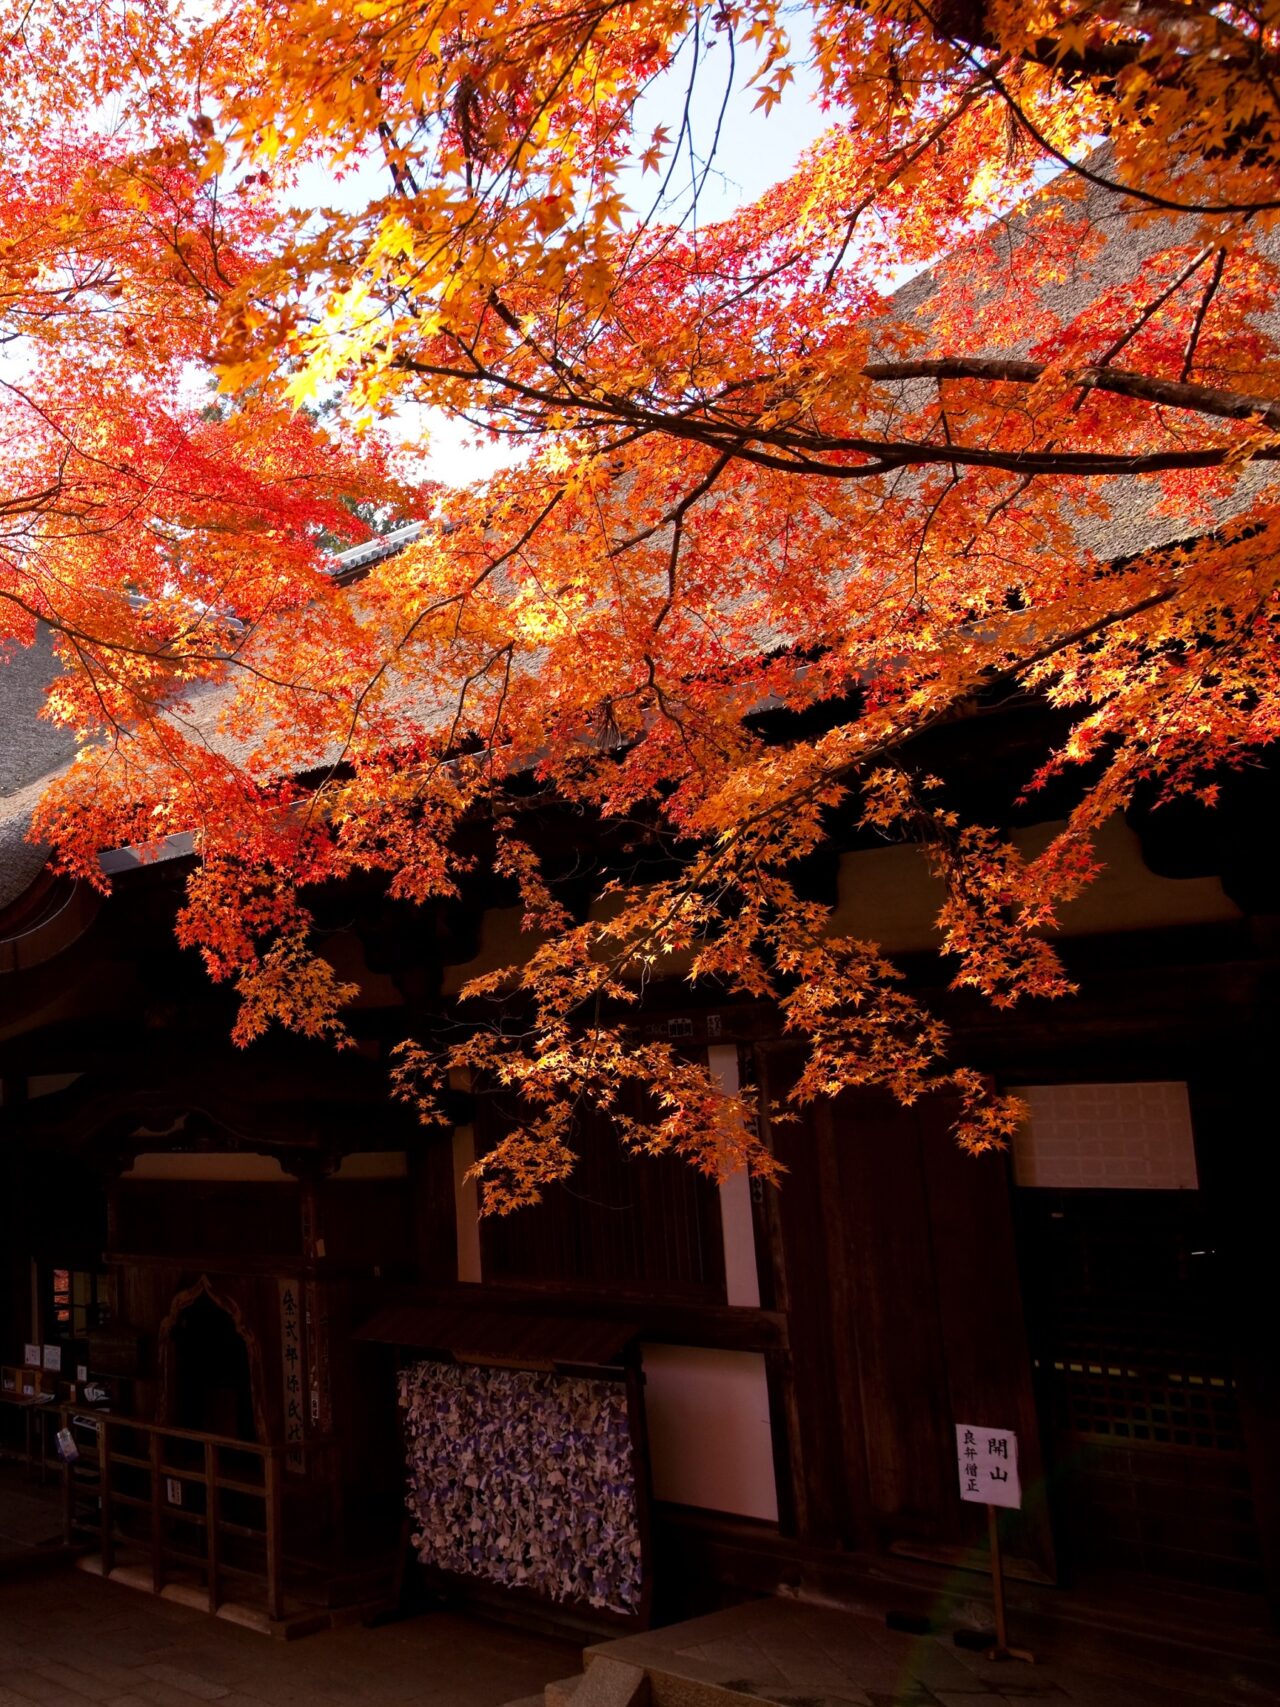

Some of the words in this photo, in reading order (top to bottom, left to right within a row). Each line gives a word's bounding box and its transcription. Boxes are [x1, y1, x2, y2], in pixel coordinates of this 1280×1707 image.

[963, 1429, 980, 1492] 良弁僧正
[987, 1438, 1008, 1482] 開山
